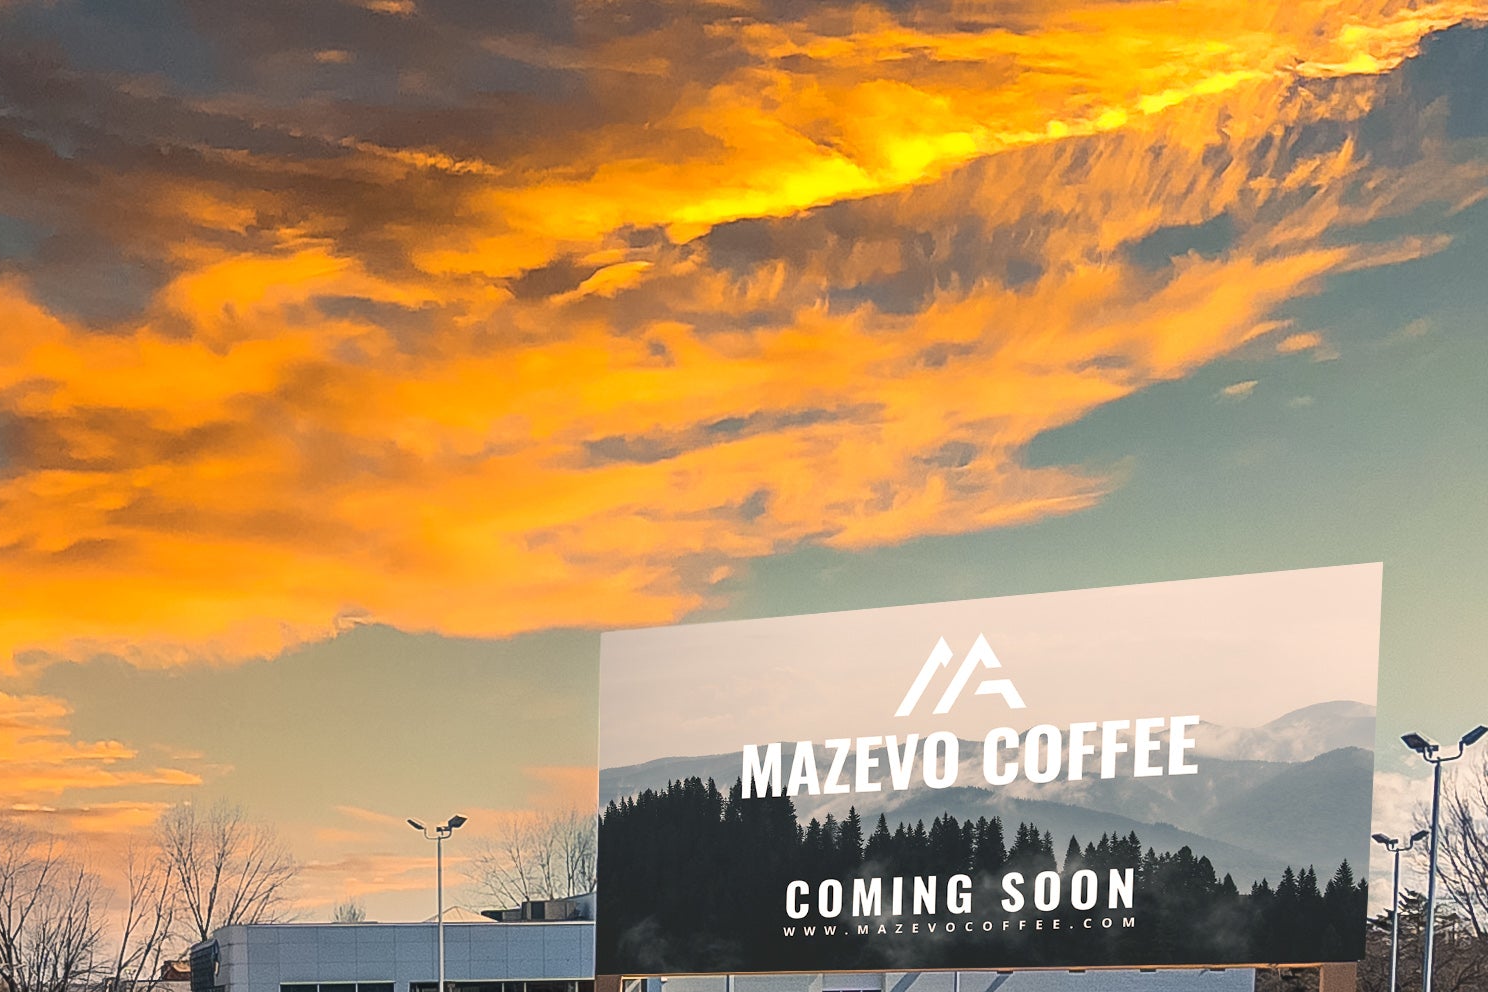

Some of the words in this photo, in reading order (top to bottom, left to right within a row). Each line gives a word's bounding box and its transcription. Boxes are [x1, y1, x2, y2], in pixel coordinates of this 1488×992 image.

[741, 731, 959, 799] MAZEVO
[983, 715, 1200, 786] COFFEE
[786, 874, 972, 919] COMING
[1002, 869, 1134, 913] SOON
[783, 917, 1136, 937] WWW.MAZEVOCOFFEE.COM
